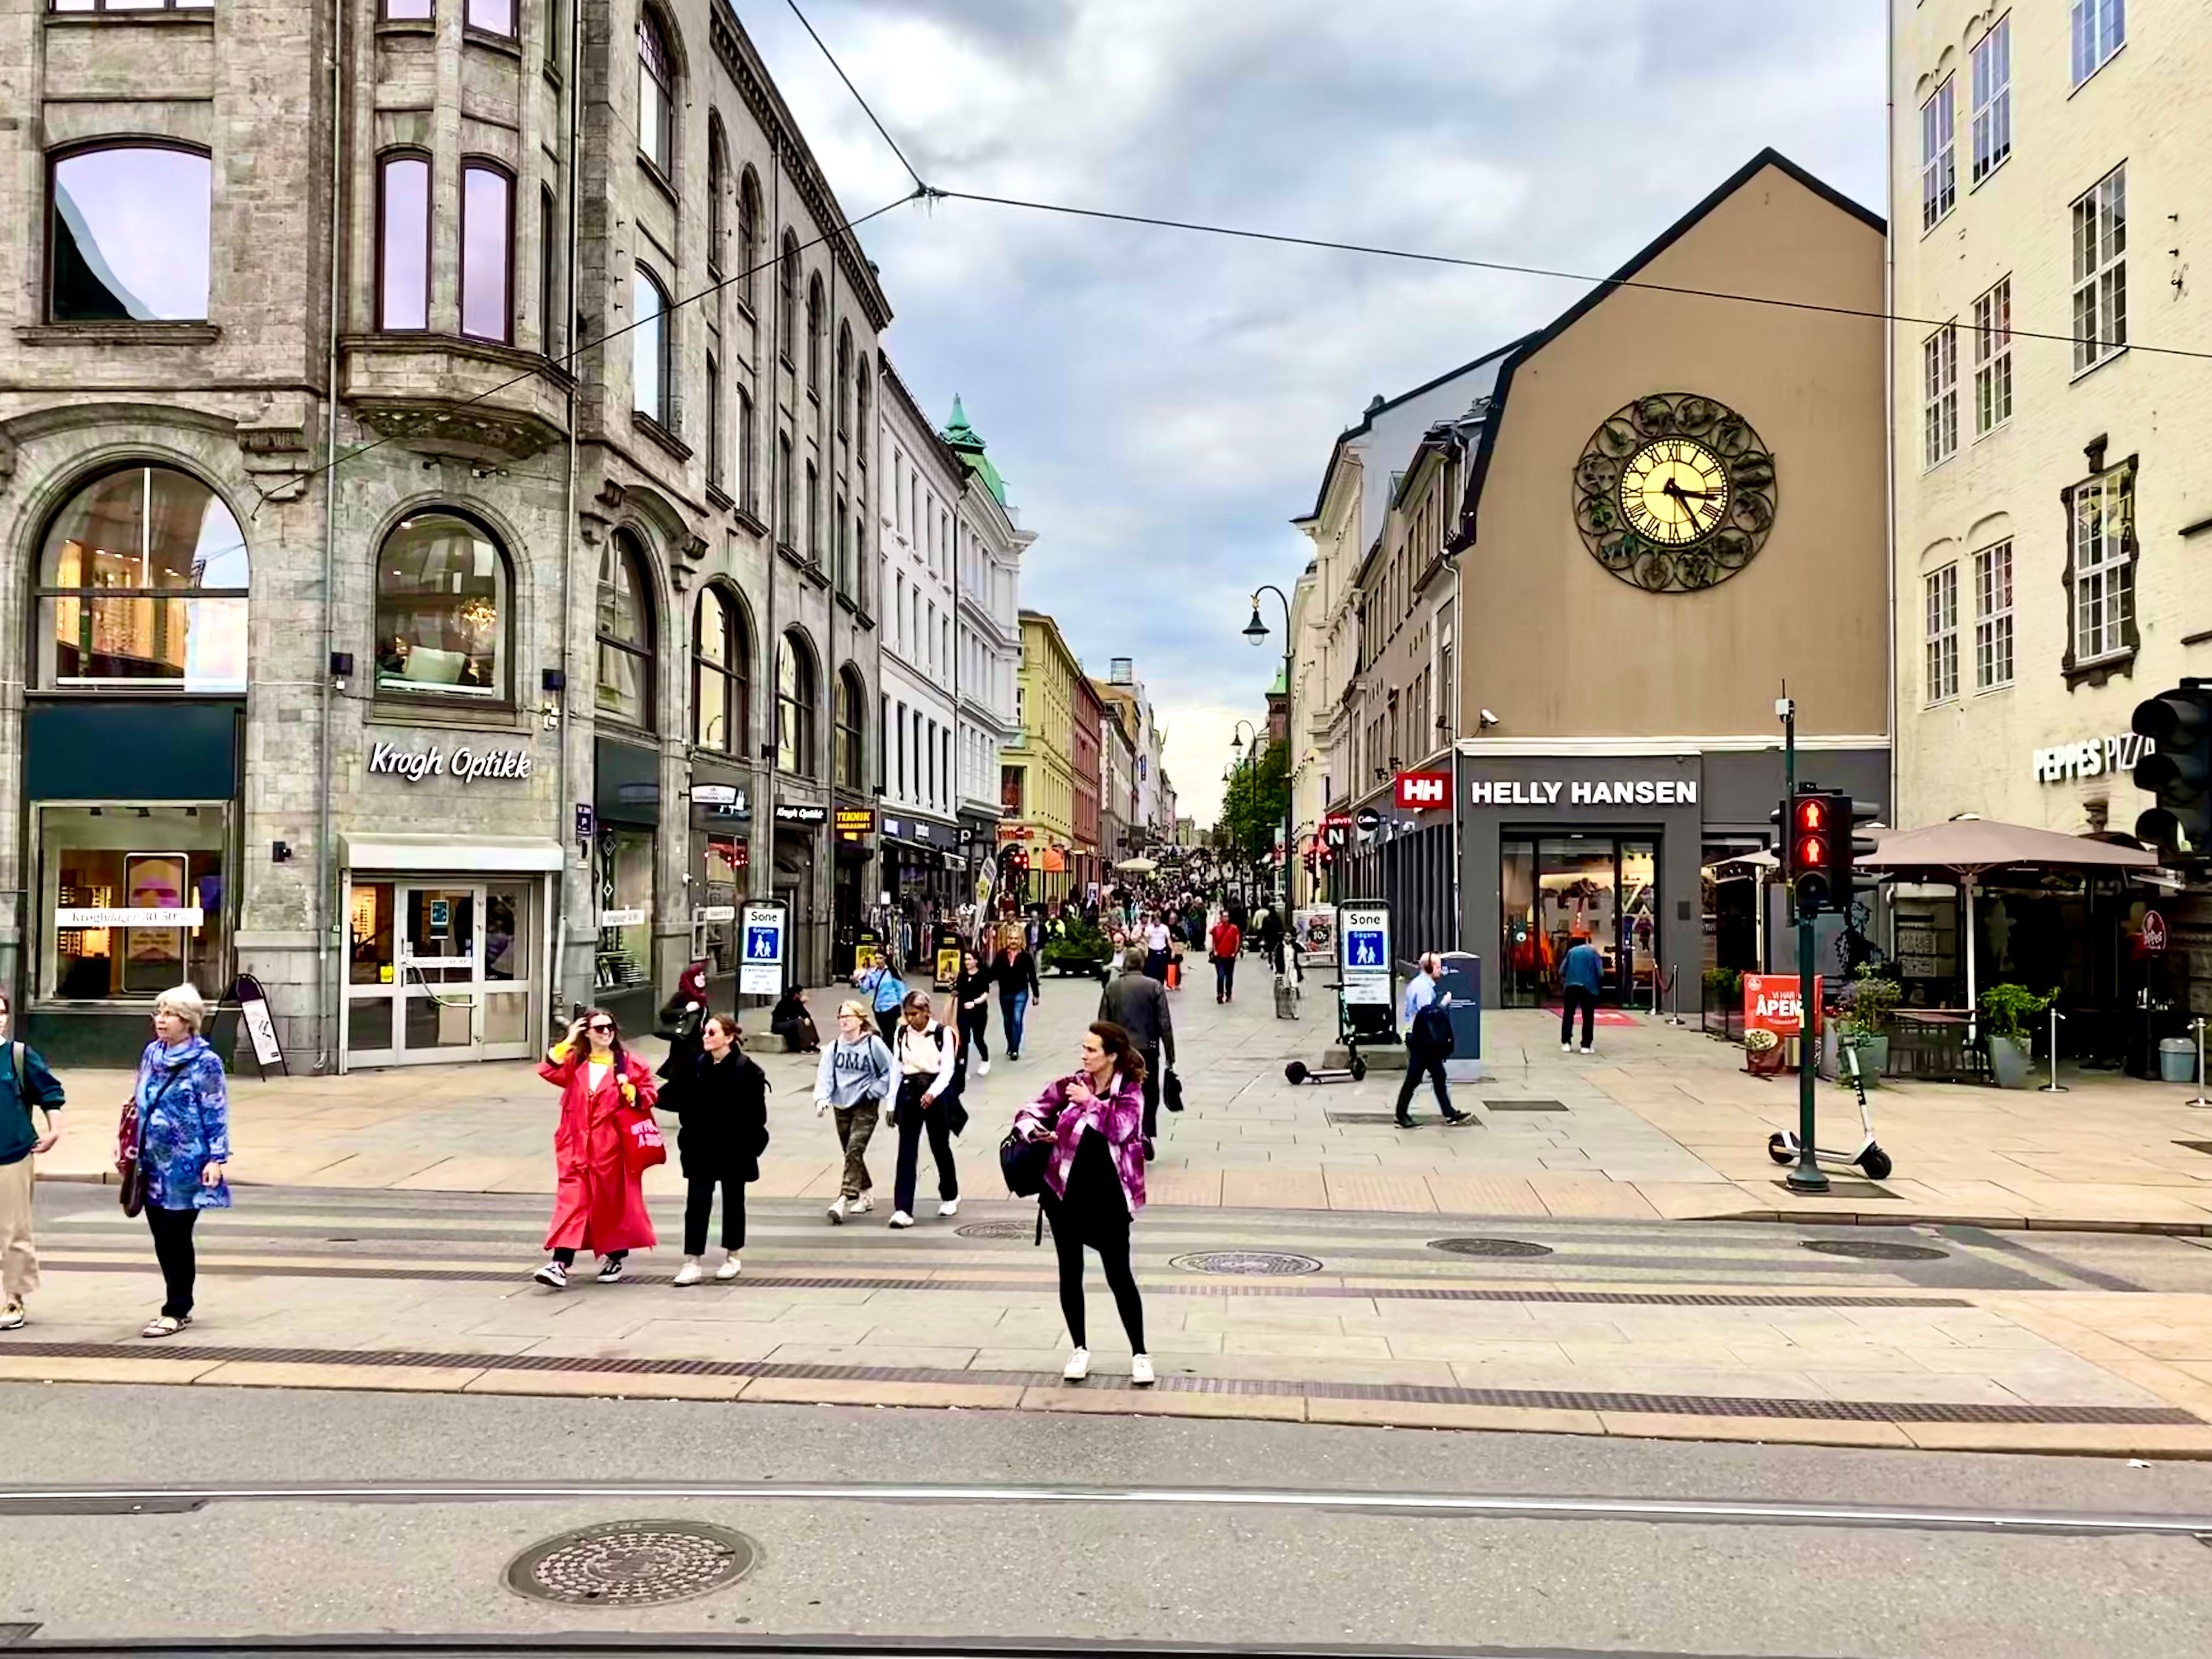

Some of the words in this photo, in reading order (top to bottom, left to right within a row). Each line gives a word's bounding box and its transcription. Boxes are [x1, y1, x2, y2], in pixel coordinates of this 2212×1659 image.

[370, 742, 443, 781] Krogh
[450, 747, 531, 783] Optikk
[2033, 738, 2102, 782] PEPPES
[1404, 779, 1443, 801] HH
[1471, 781, 1562, 804] HELLY
[1571, 781, 1697, 804] HANSEN
[836, 811, 871, 822] TEKNIK
[1328, 828, 1344, 845] N
[751, 911, 777, 922] Sone
[1350, 913, 1380, 924] Sone
